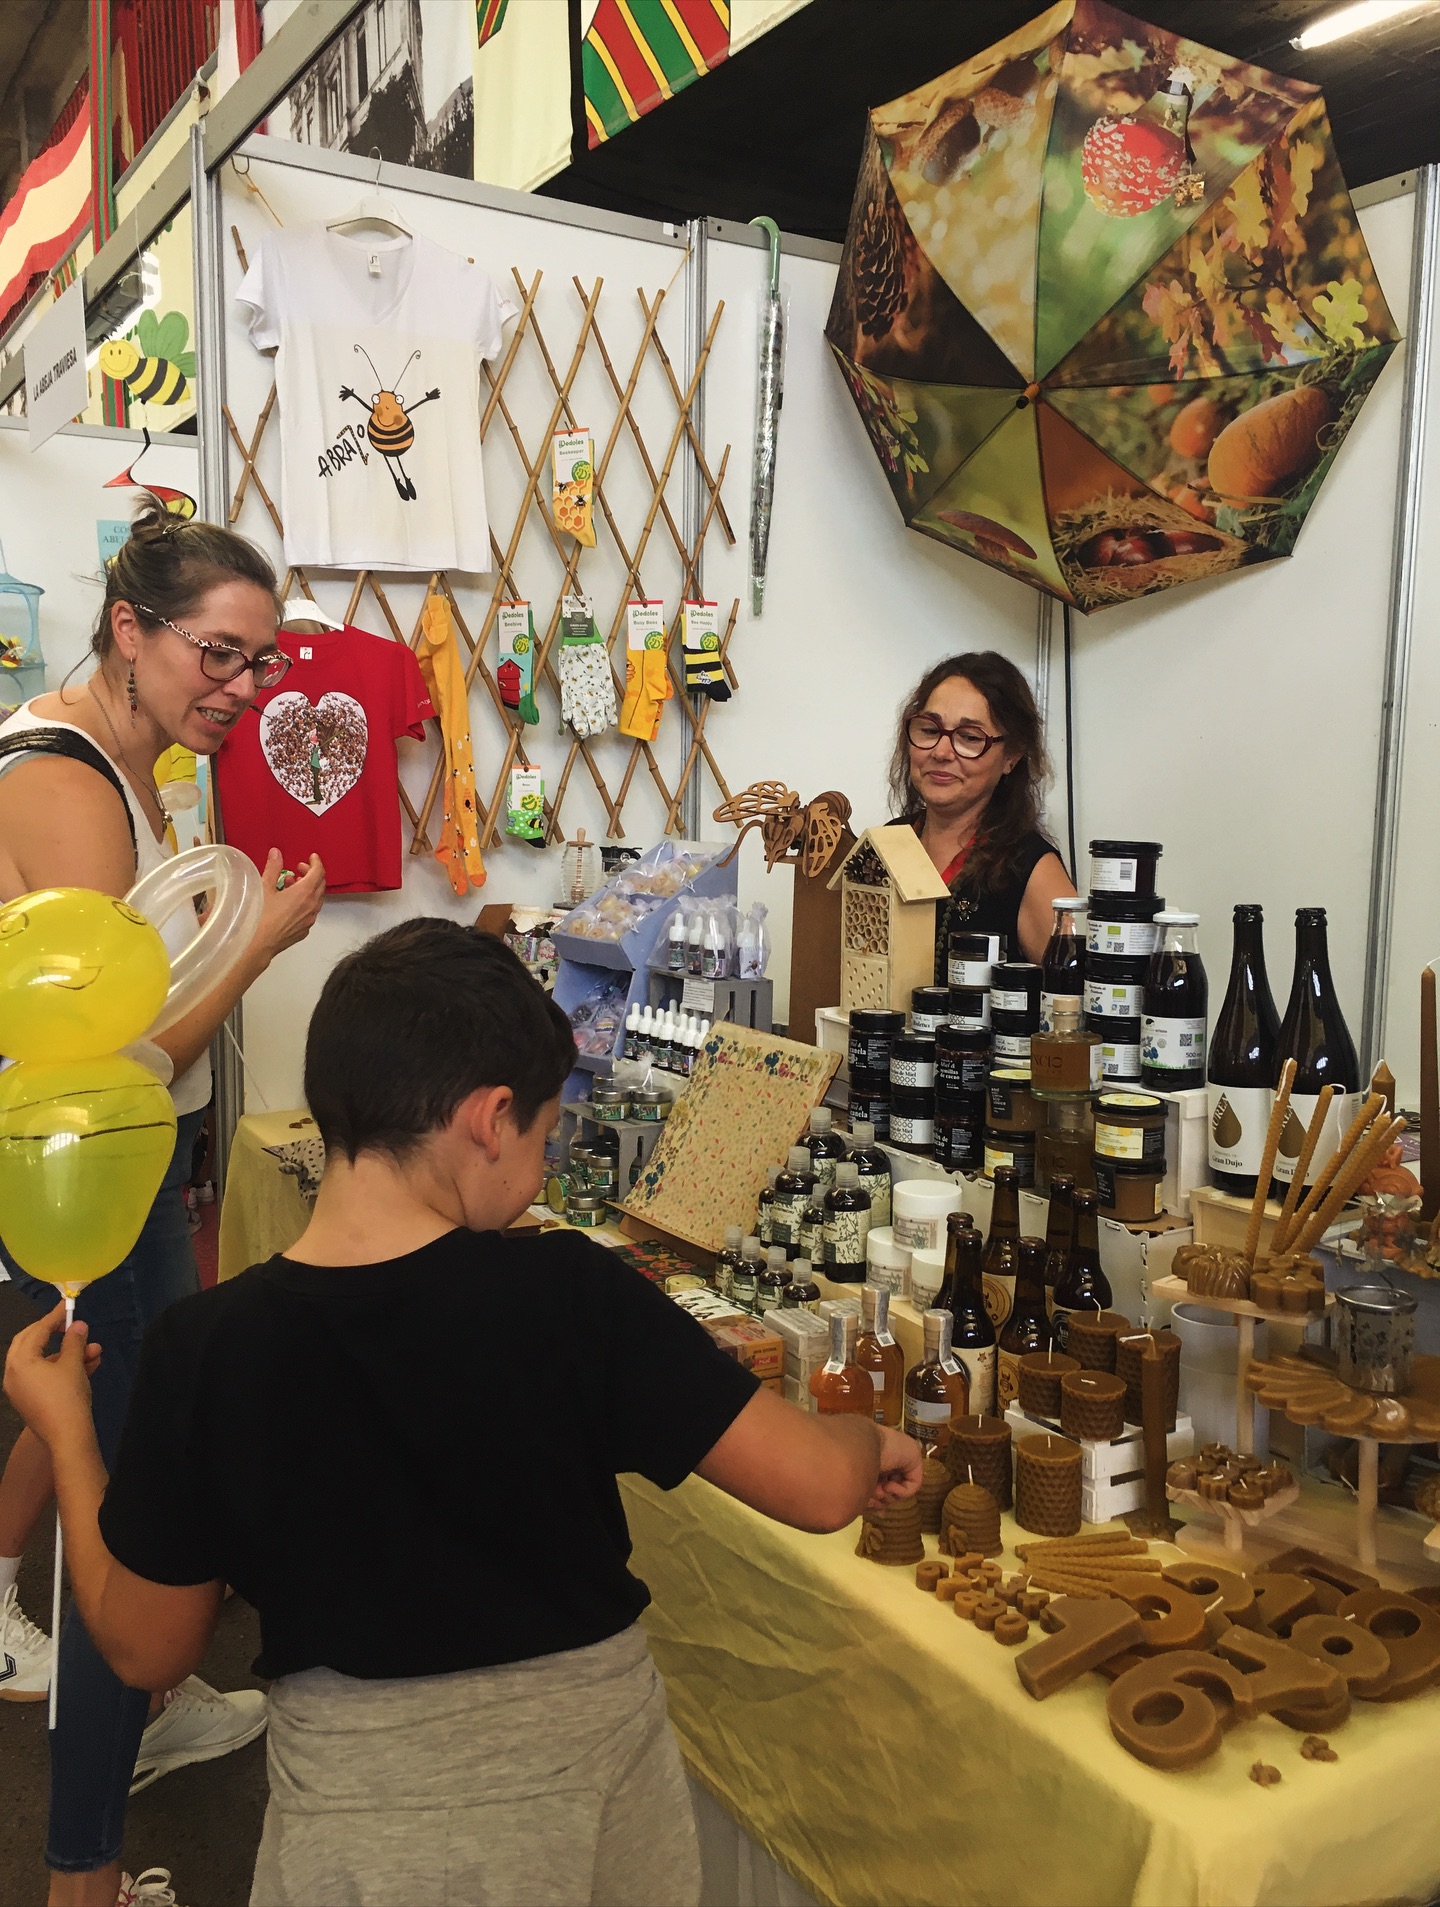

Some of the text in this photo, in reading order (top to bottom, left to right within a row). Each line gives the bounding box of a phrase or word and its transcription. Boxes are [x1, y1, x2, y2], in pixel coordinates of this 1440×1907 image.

[33, 346, 78, 402] LA ABEJA TRAVIESA
[318, 423, 369, 478] ABRAZO
[1212, 1155, 1243, 1169] Gran Dujo
[1275, 1165, 1291, 1176] Gran
